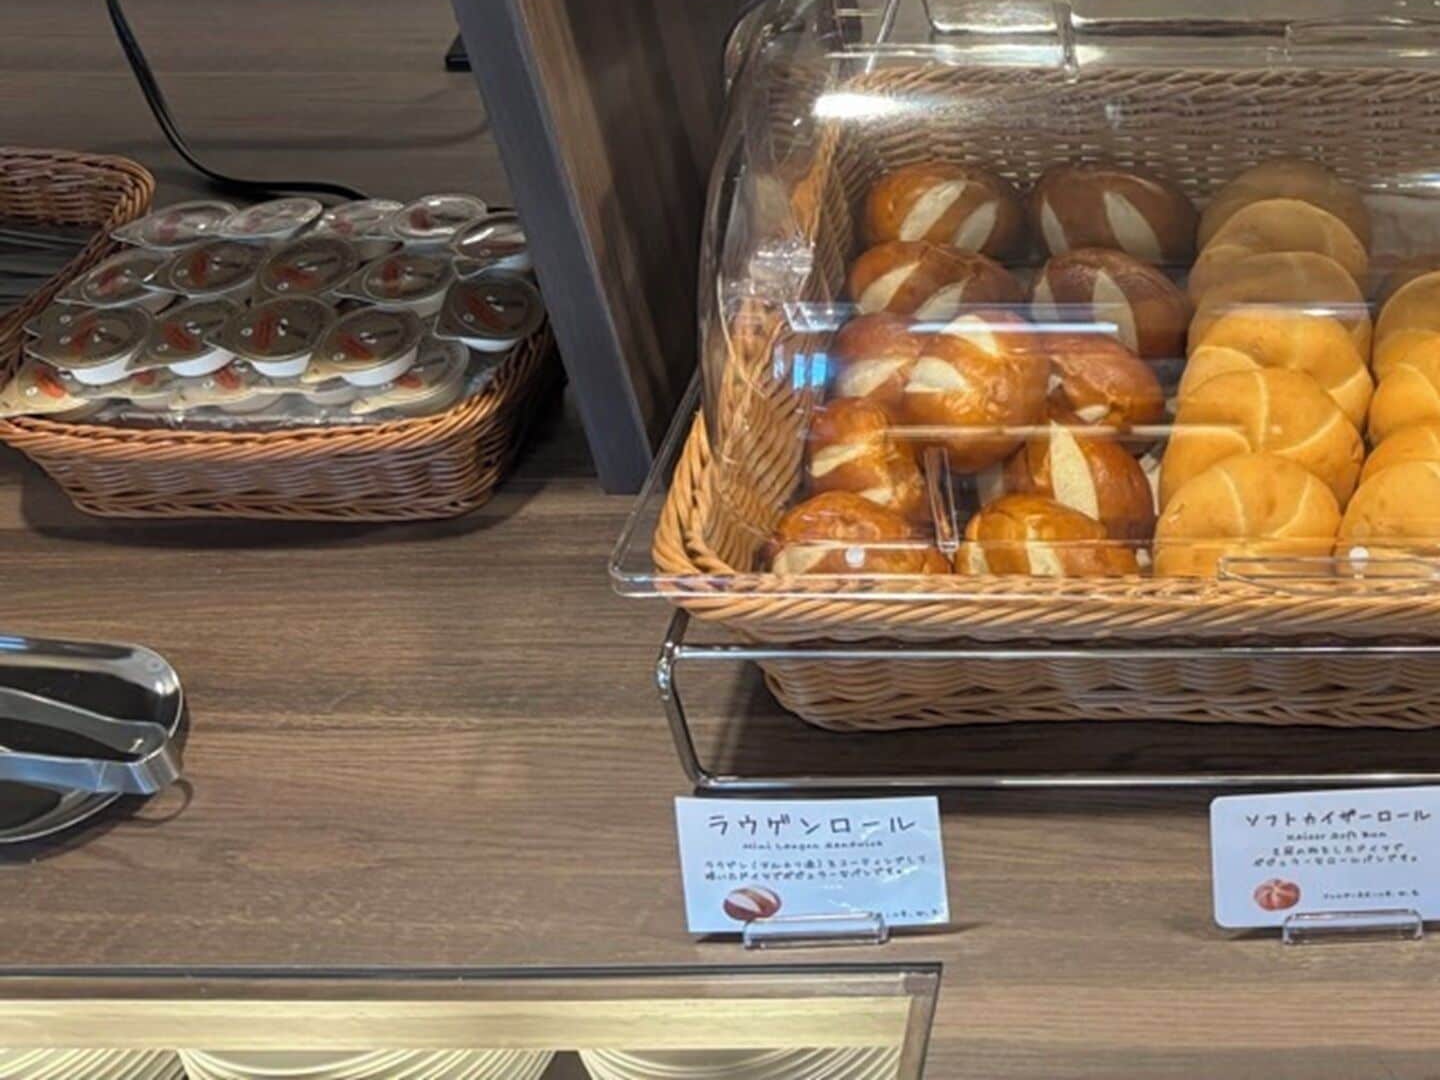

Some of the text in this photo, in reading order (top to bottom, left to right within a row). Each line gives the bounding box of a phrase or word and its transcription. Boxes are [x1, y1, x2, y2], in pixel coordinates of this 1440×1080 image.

[709, 814, 915, 836] ラウゲンロール
[1246, 808, 1431, 827] ソフトカイザーロール
